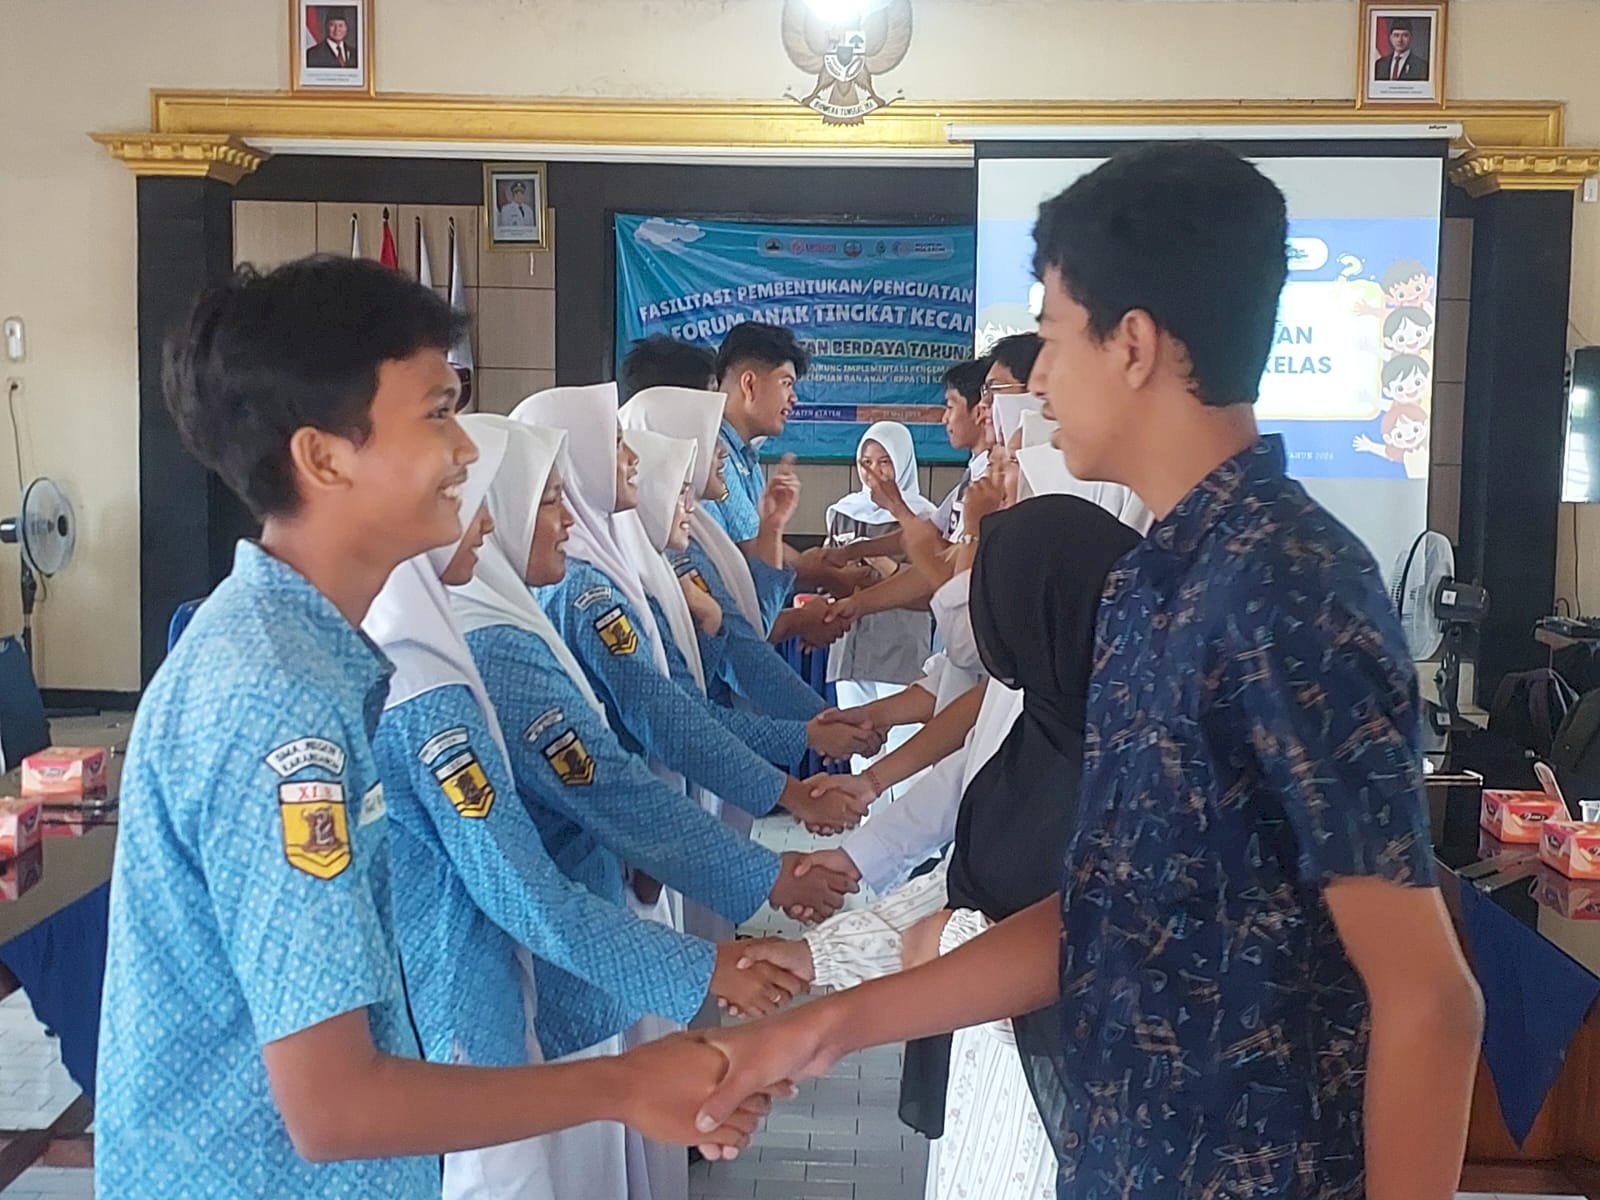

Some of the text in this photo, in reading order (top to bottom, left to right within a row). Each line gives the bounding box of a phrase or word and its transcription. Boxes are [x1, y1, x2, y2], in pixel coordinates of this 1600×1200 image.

[638, 277, 974, 322] FASILITASI PEMBENTUKAN/PENGUATAN
[671, 312, 746, 341] FORUM
[752, 304, 809, 326] ANAK
[813, 303, 907, 324] TINGKAT
[832, 340, 907, 356] BERDAYA
[908, 342, 965, 360] TAHUN
